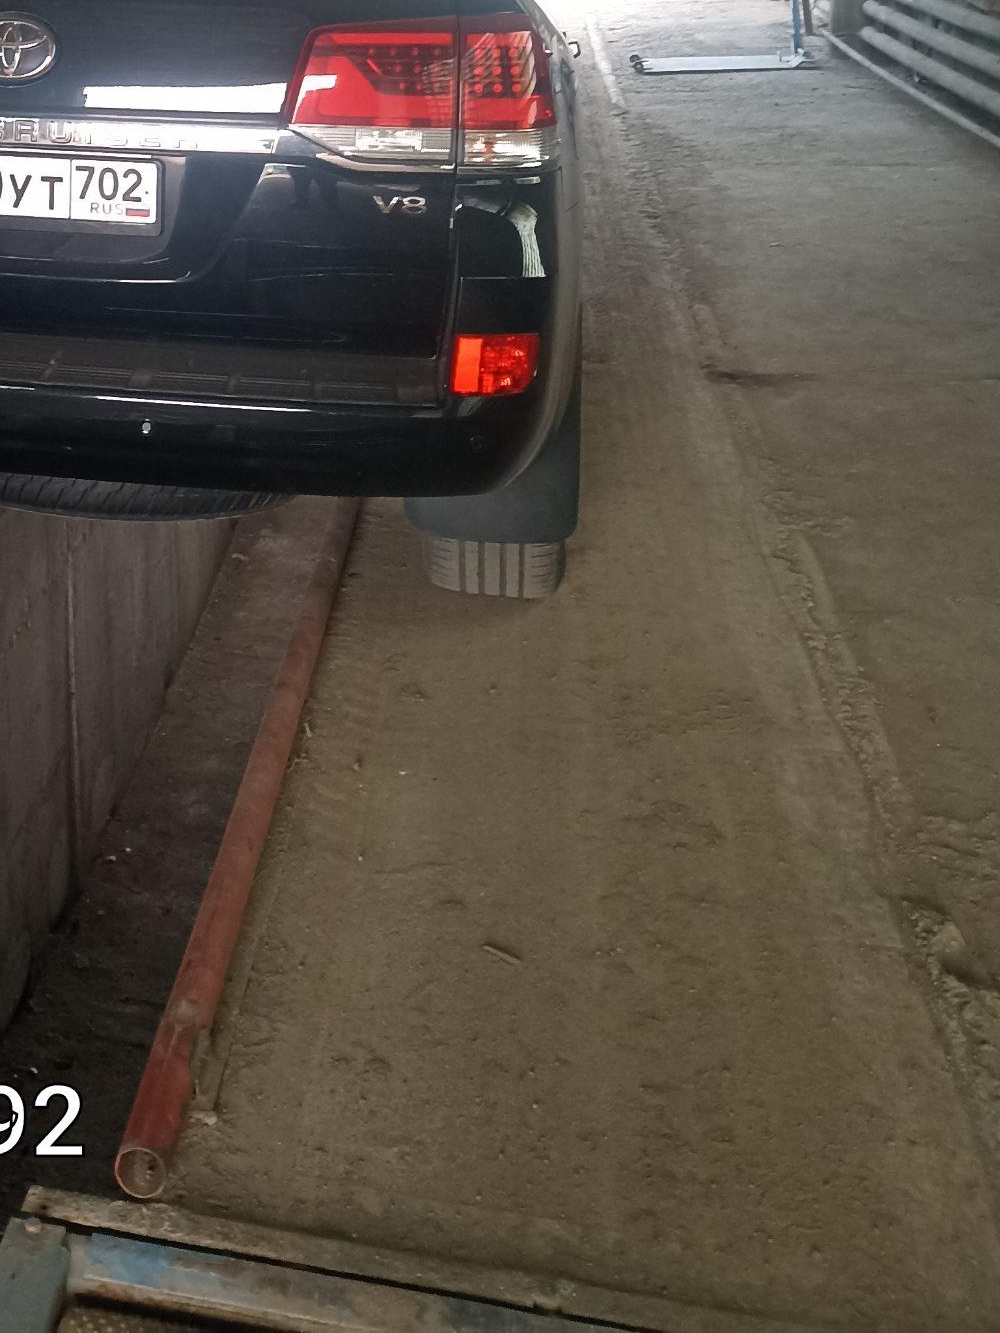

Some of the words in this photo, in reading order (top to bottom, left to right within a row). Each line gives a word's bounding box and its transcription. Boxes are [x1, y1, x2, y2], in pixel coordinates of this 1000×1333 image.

[75, 165, 142, 202] 702
[89, 201, 125, 215] RUS
[372, 195, 427, 214] V8
